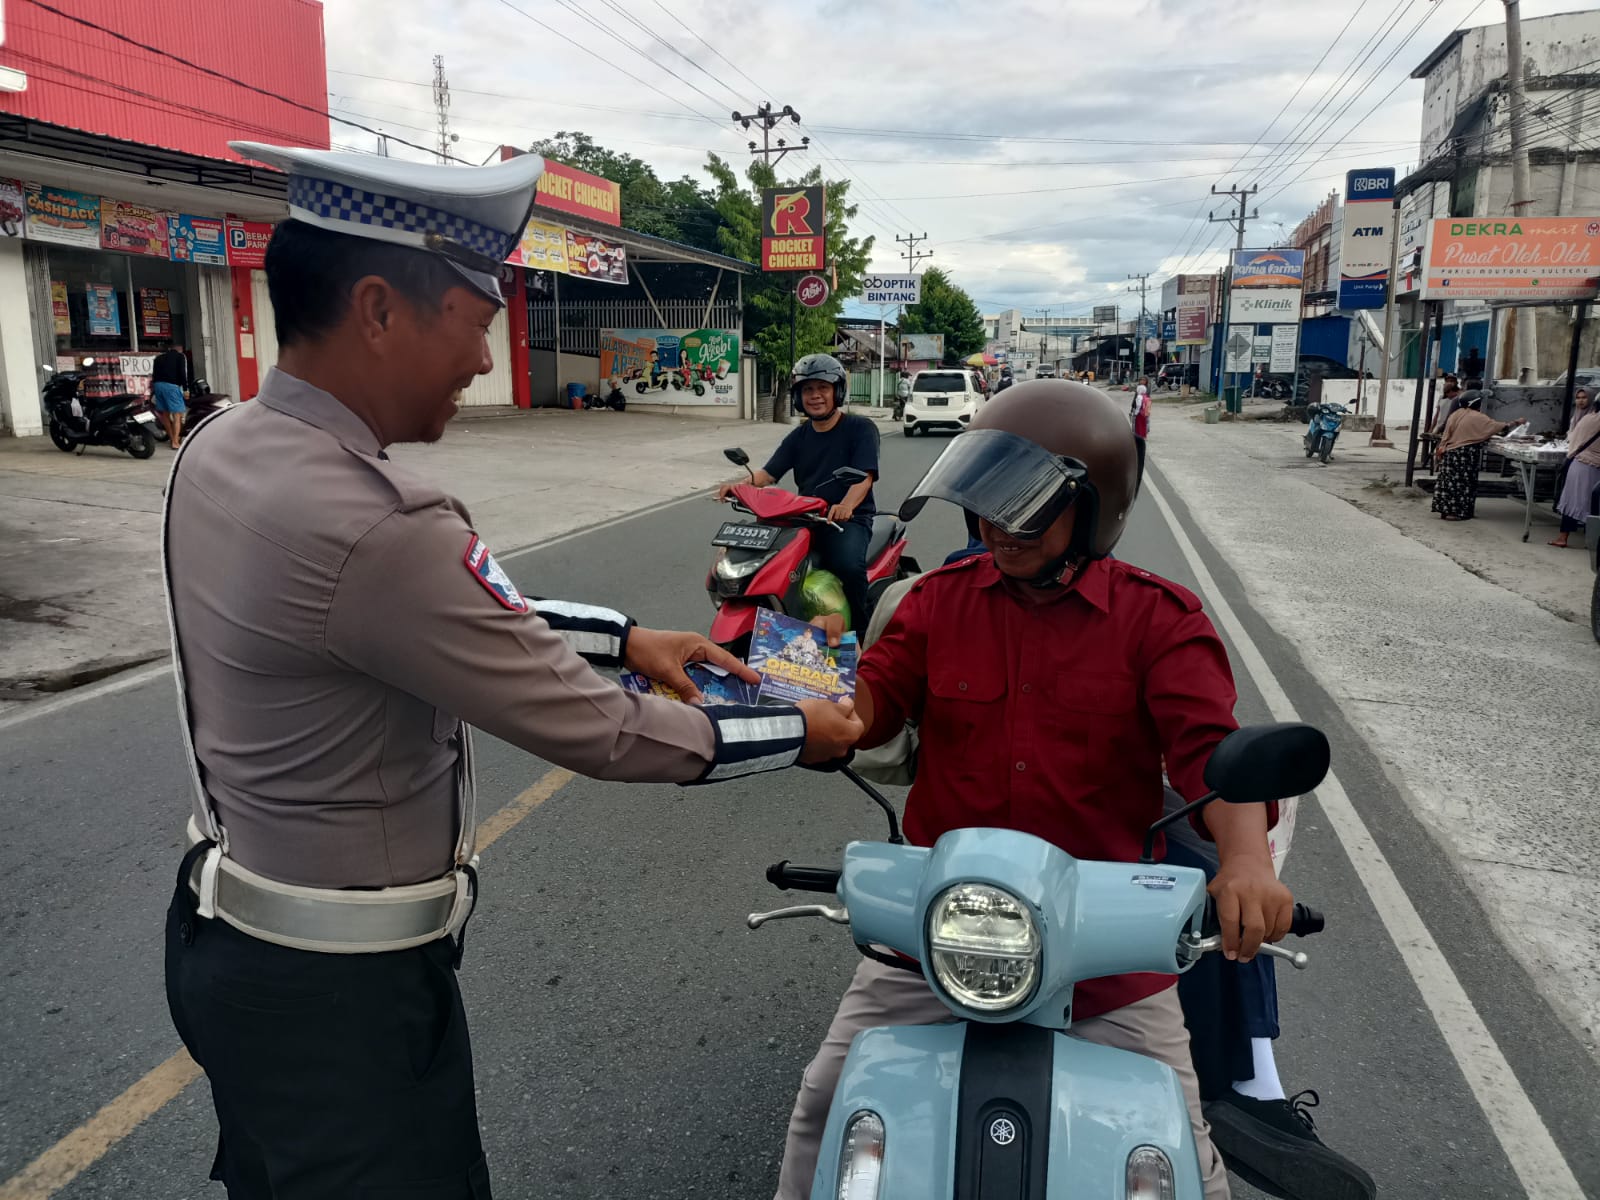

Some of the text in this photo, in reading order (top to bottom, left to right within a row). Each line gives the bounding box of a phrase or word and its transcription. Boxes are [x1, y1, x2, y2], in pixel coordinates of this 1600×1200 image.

[1368, 178, 1389, 190] BRI
[574, 181, 614, 213] CHICKEN
[27, 196, 97, 221] CASHBACK
[1352, 227, 1383, 237] ATM
[1450, 223, 1523, 236] DEKRA
[247, 240, 268, 249] PARK
[771, 239, 814, 253] ROCKET
[1444, 242, 1501, 264] Pusat
[768, 253, 816, 268] CHICKEN
[883, 279, 916, 289] OPTIK
[868, 292, 916, 302] BINTANG
[1254, 299, 1293, 309] Klinik
[121, 358, 151, 373] PRO
[766, 658, 840, 688] OPERASI
